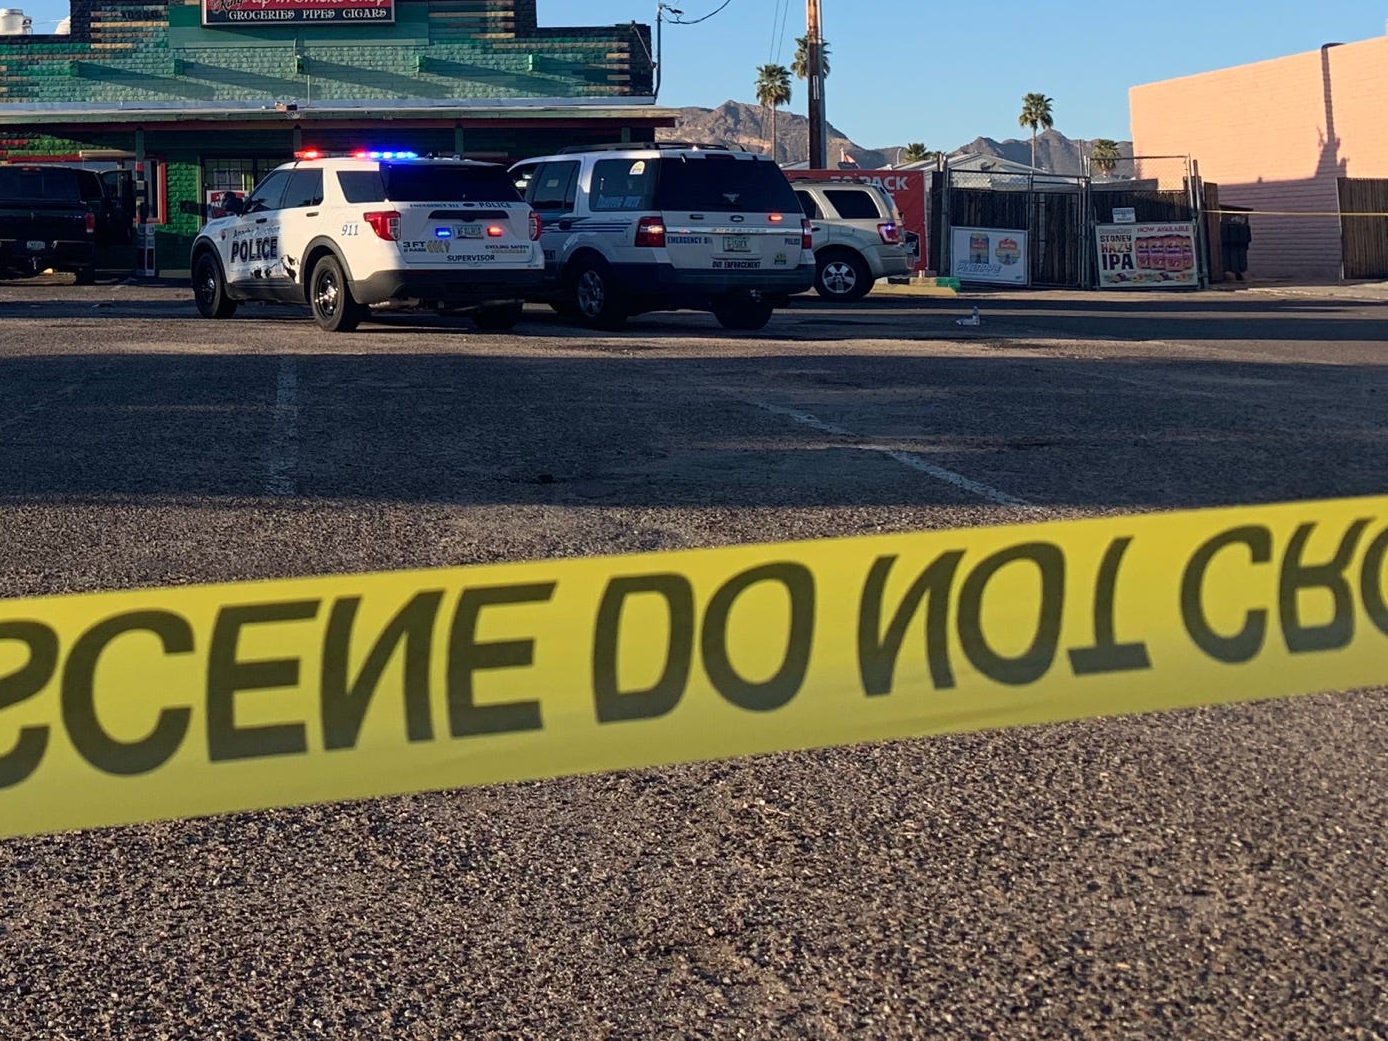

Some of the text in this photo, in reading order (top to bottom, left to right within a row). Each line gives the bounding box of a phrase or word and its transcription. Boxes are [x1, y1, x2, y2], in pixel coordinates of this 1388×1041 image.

[228, 8, 387, 20] GROCERIES PIPES CIGARS
[341, 224, 359, 236] 911
[667, 236, 702, 244] EMERGENCY
[1100, 234, 1132, 243] STONEY
[231, 236, 279, 263] POLICE
[1101, 243, 1132, 253] HAZY
[447, 254, 496, 262] SUPERVISOR
[1102, 253, 1134, 270] IPA
[724, 261, 762, 269] ENFORCEMENT
